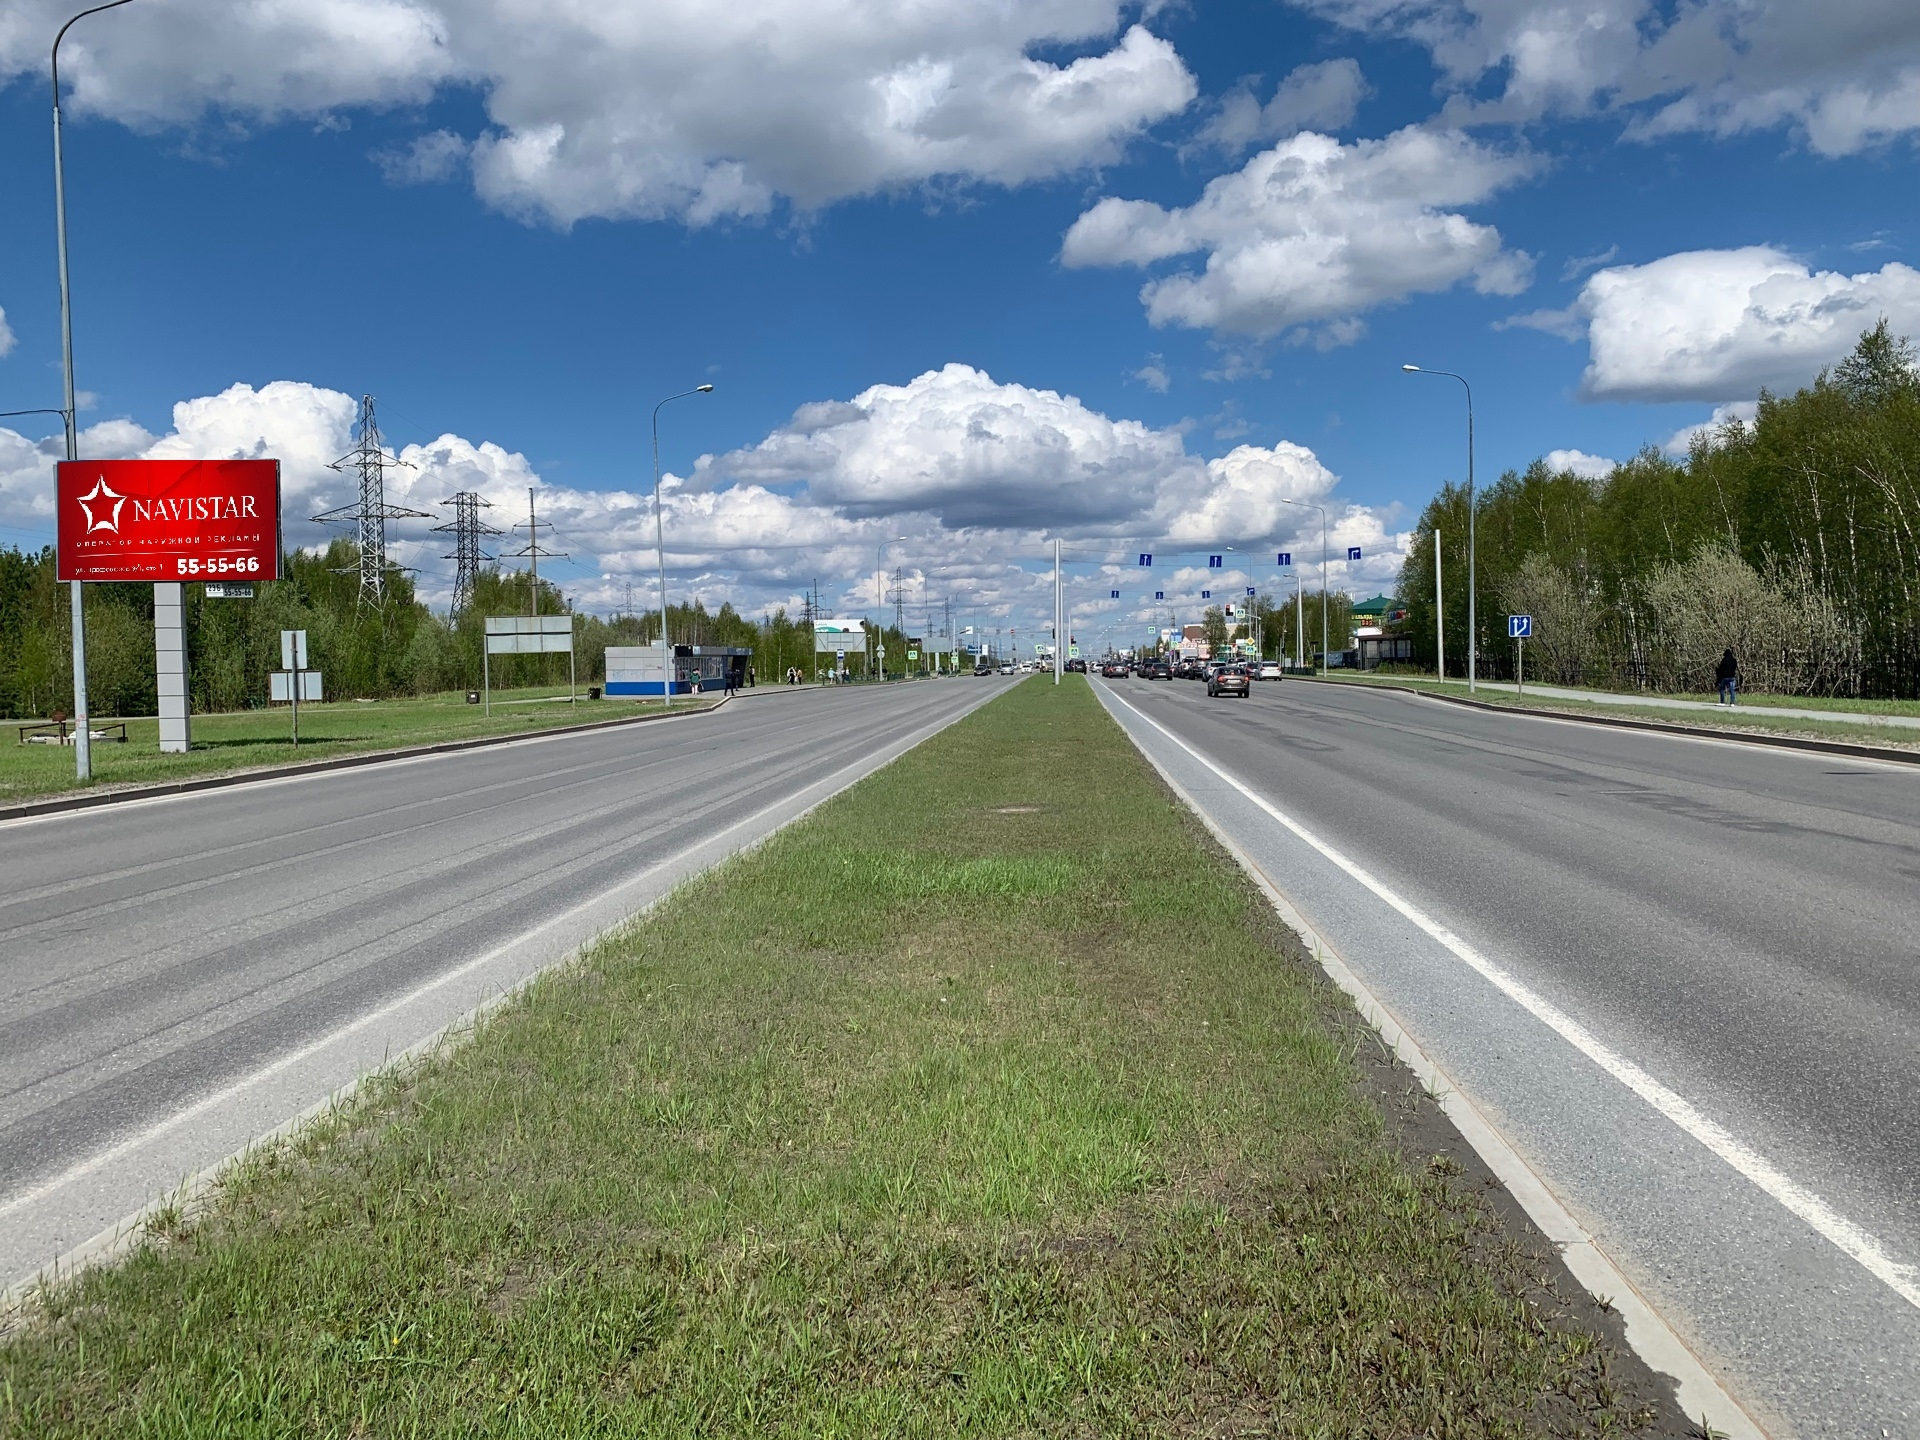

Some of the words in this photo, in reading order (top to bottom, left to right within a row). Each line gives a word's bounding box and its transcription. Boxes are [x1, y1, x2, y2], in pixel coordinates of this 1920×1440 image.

[133, 495, 260, 522] NAVISTAR
[177, 557, 260, 575] 55-55-66
[224, 588, 252, 597] 55-55-66
